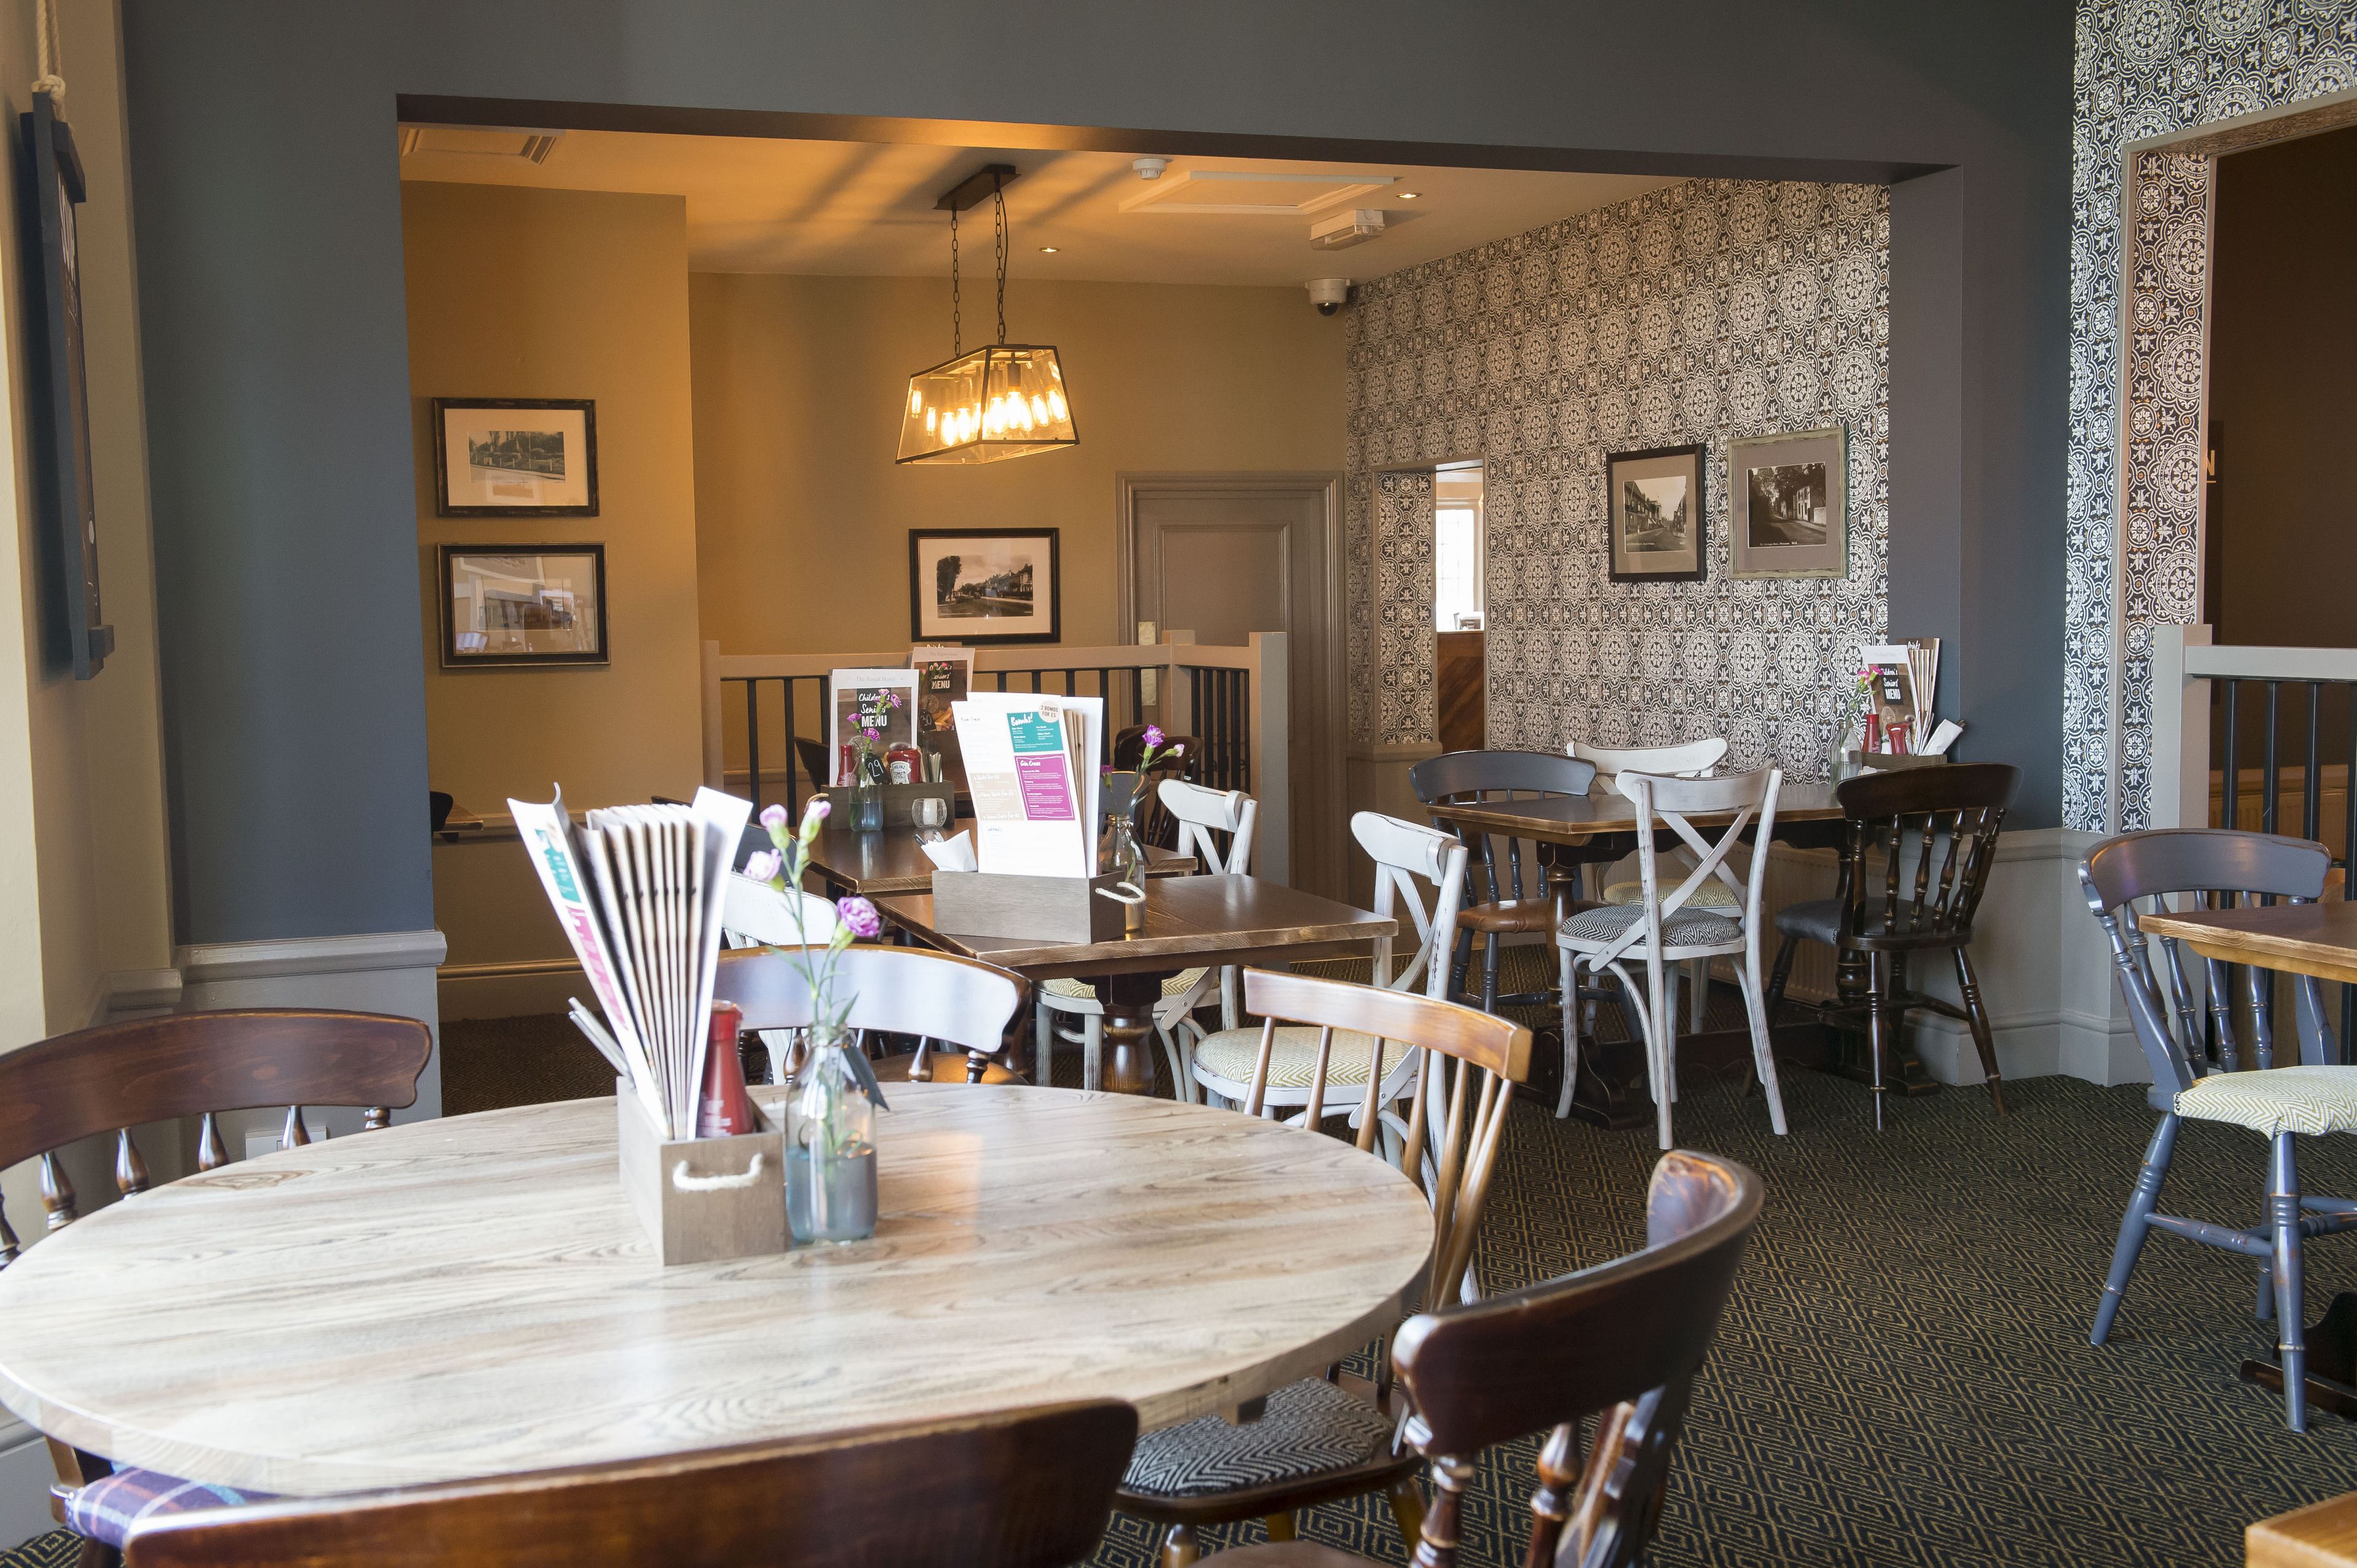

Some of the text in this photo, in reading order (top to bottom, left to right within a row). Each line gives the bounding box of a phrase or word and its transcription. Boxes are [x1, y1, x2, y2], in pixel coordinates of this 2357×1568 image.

[1885, 689, 1901, 700] MENU
[861, 715, 888, 727] MENU
[920, 714, 932, 726] 30
[1010, 713, 1033, 726] Bombs!
[868, 759, 884, 778] 29
